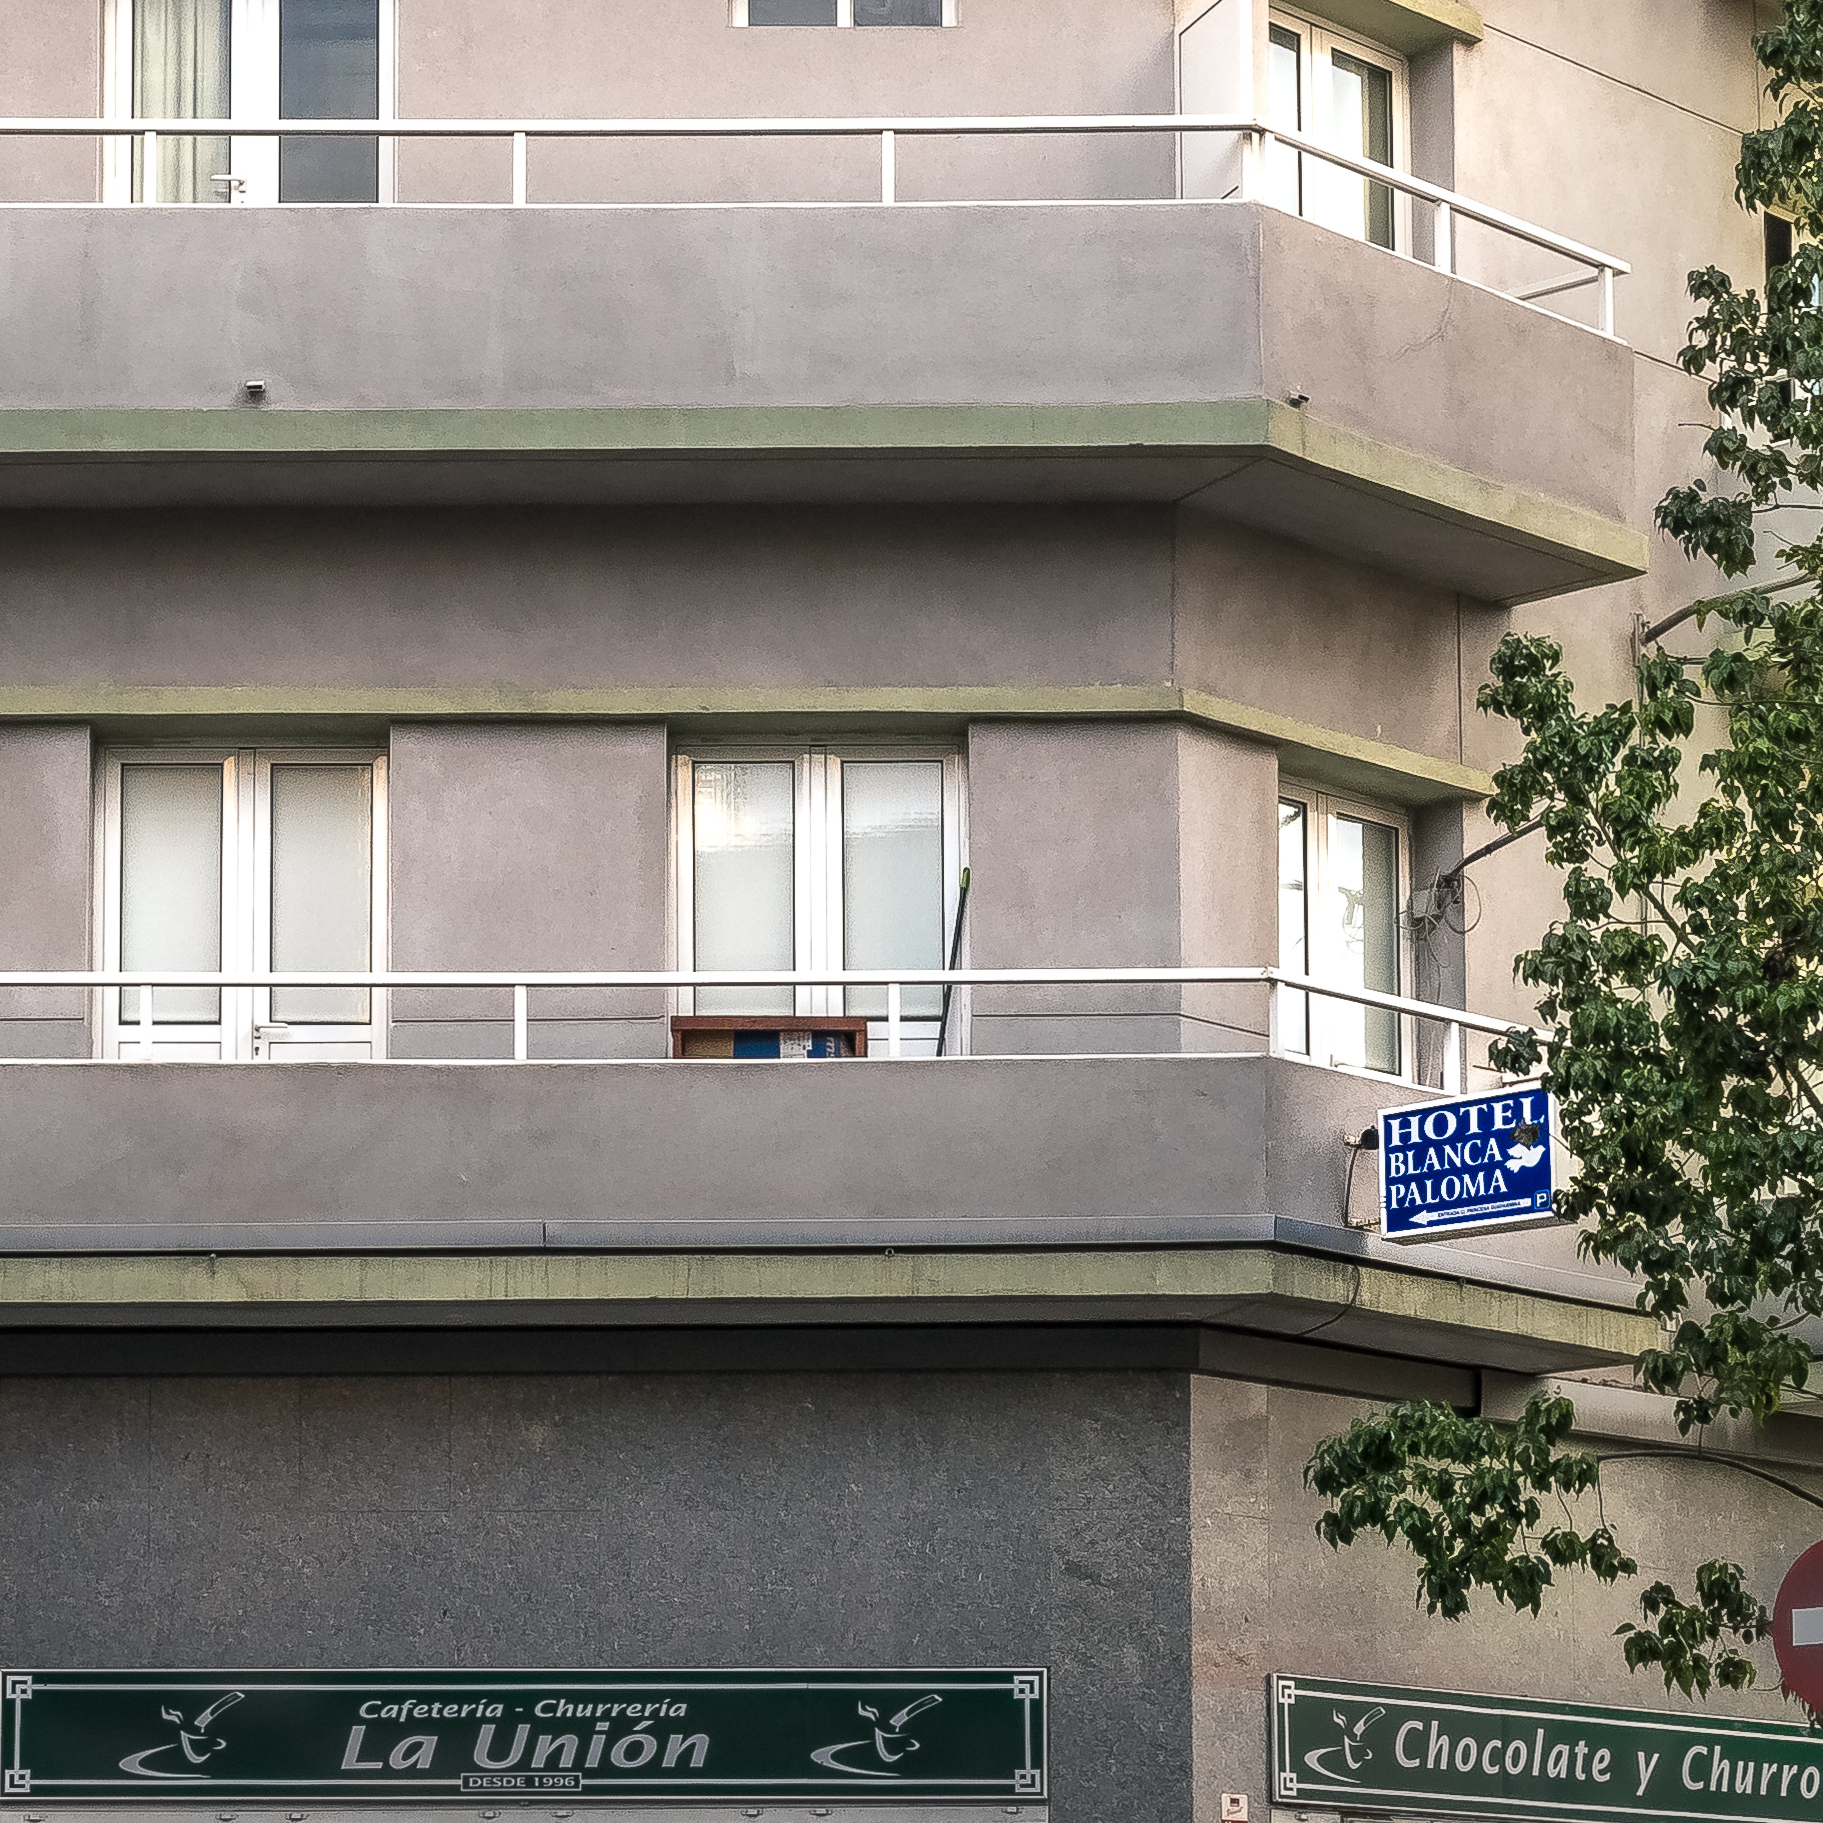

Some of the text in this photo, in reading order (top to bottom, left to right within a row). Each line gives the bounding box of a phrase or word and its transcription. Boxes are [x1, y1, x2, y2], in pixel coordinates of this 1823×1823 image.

[1387, 1096, 1545, 1148] HOTEL
[1388, 1137, 1504, 1178] BLANCA
[1389, 1168, 1509, 1210] PALOMA
[359, 1699, 504, 1722] Cafetería
[534, 1699, 688, 1719] Churrería
[340, 1720, 710, 1770] La Unión
[1394, 1719, 1612, 1783] Chocolate
[1636, 1751, 1660, 1796] y
[468, 1776, 575, 1788] DESDE 1996
